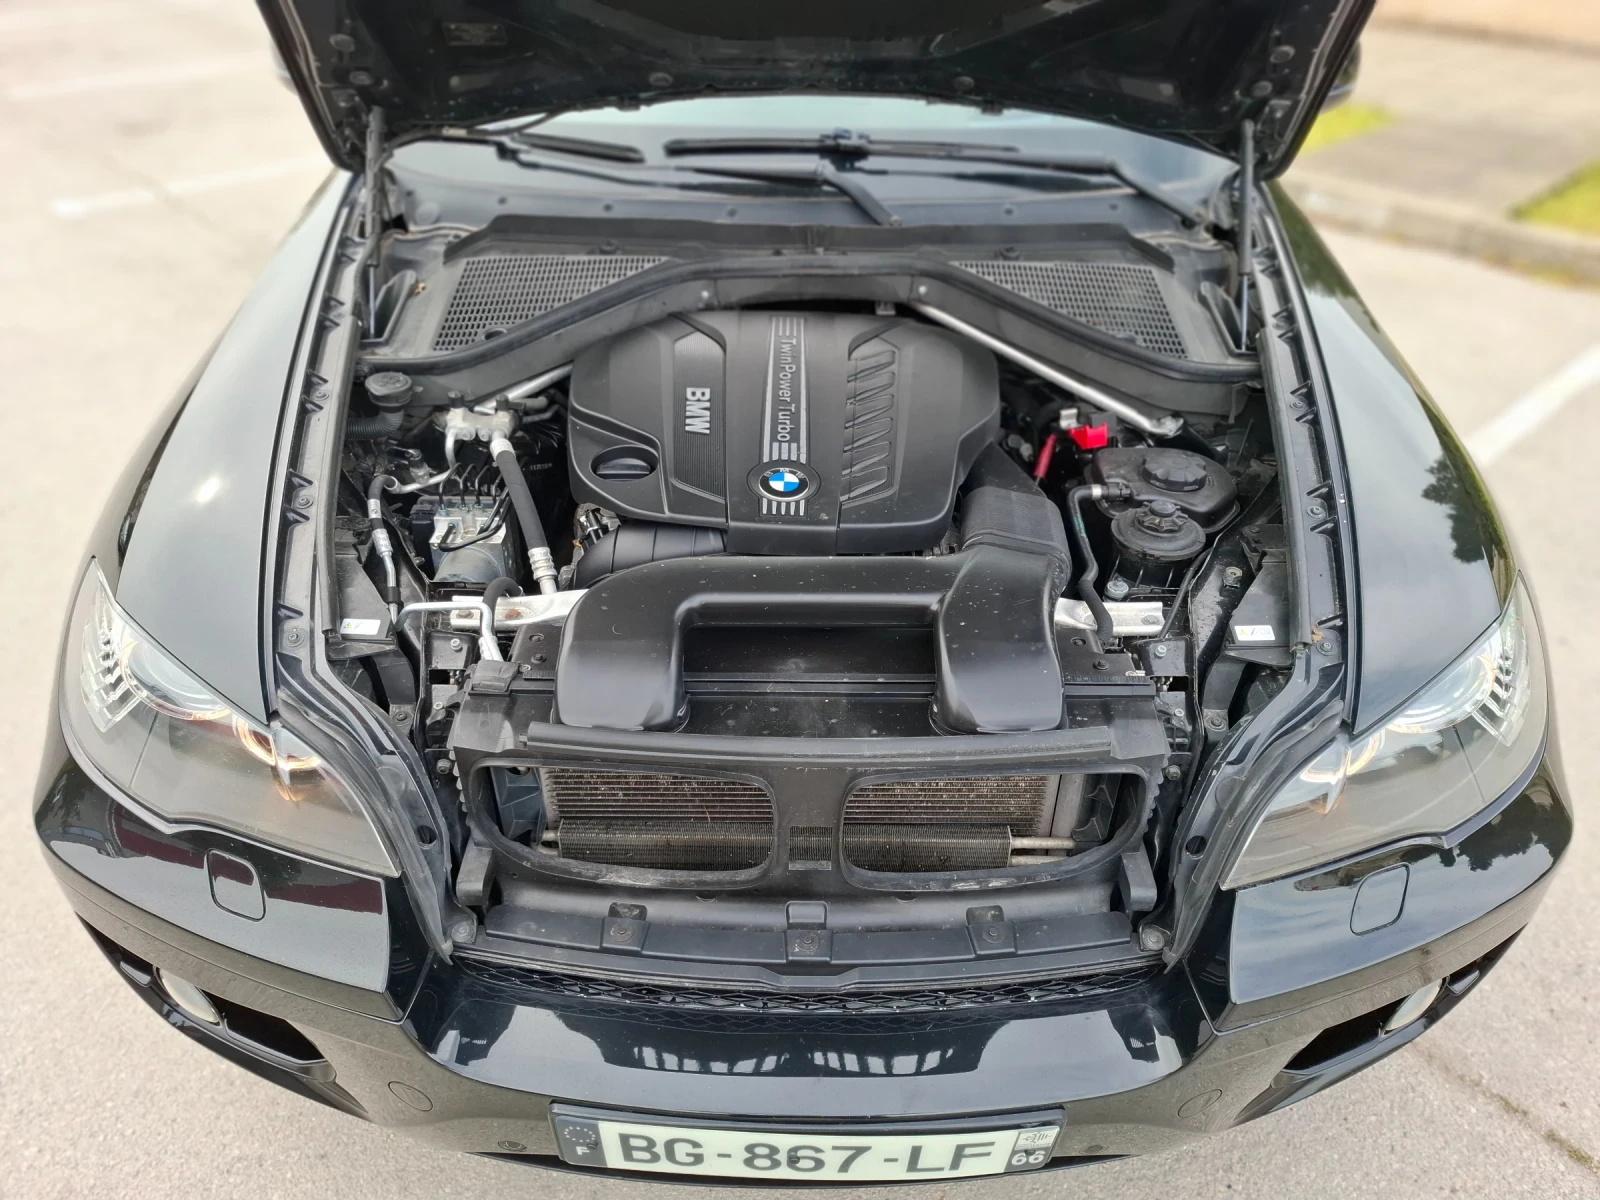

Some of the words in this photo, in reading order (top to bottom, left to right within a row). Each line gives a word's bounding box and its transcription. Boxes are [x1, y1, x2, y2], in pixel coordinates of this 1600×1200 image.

[778, 338, 797, 402] TwinPower
[685, 387, 710, 434] BMW
[777, 404, 795, 441] Turbo
[576, 1146, 591, 1156] F
[1011, 1150, 1046, 1166] 66
